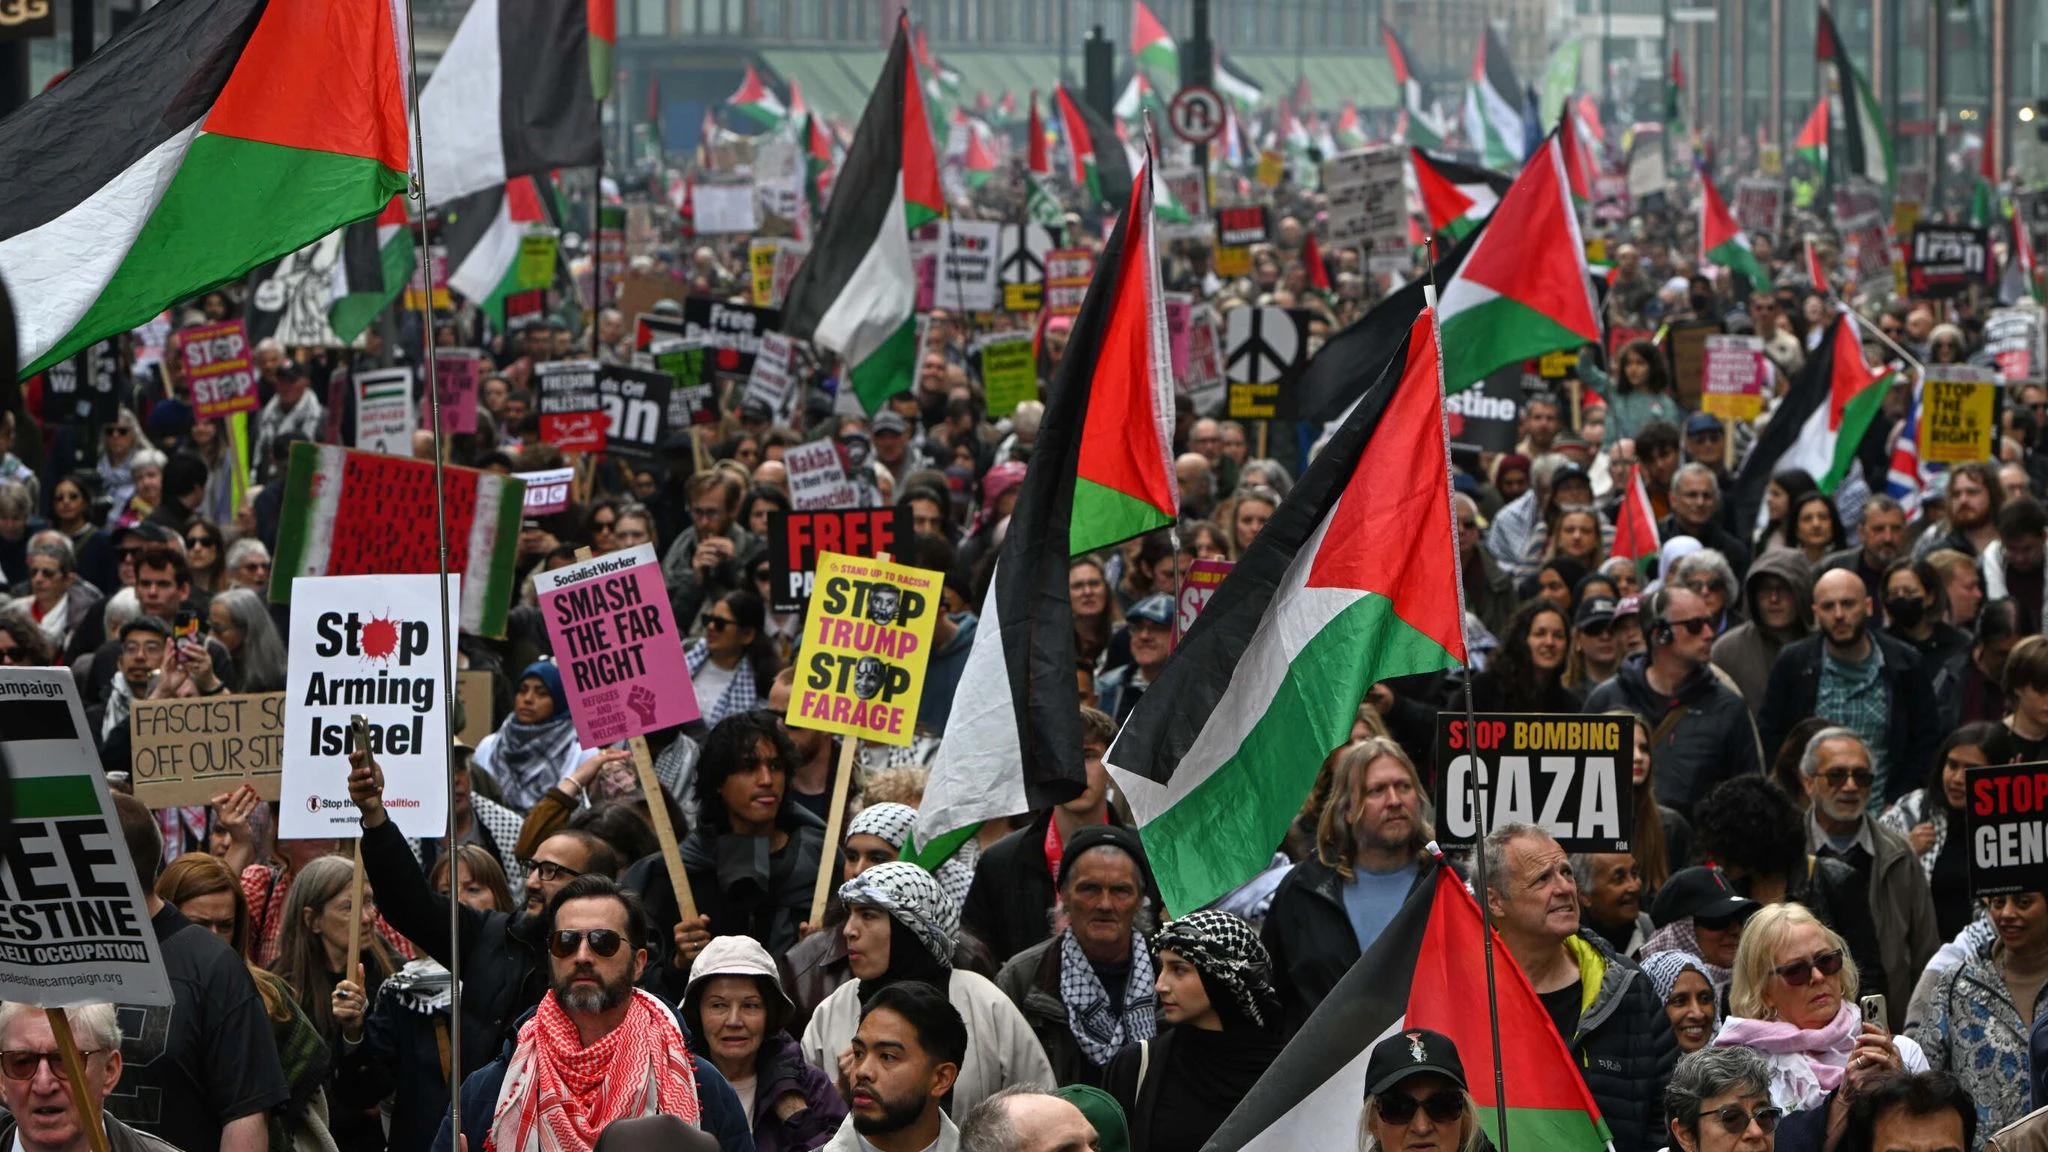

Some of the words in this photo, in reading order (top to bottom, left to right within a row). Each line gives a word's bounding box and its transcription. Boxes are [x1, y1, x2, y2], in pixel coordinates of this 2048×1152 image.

[710, 303, 756, 331] Free
[541, 373, 596, 392] FREEDOM
[1933, 383, 1977, 398] STOP
[1934, 399, 1962, 412] THE
[1932, 415, 1961, 428] FAR
[1931, 430, 1982, 444] RIGHT
[788, 447, 834, 476] Nakba
[787, 510, 896, 571] FREE
[553, 562, 598, 587] Socialist
[598, 556, 637, 575] Worker
[841, 564, 868, 577] STAND
[871, 568, 882, 578] UP
[885, 571, 895, 580] TO
[898, 574, 930, 588] RACISM
[553, 574, 642, 625] SMASH
[823, 577, 926, 627] STOP
[561, 618, 612, 659] THE
[613, 604, 664, 645] FAR
[819, 616, 918, 660] TRUMP
[571, 644, 646, 692] RIGHT
[807, 651, 911, 703] STOP
[304, 670, 434, 713] Arming
[582, 689, 620, 708] REFUGEES
[136, 700, 248, 736] FASCIST
[587, 711, 627, 730] MIGRANTS
[597, 703, 613, 716] AND
[800, 691, 905, 735] FARAGE
[310, 715, 424, 756] Israel
[592, 723, 628, 742] WELCOME
[1449, 720, 1507, 749] STOP
[1514, 721, 1620, 750] BOMBING
[135, 745, 184, 778] OFF
[190, 737, 245, 773] OUR
[322, 799, 342, 810] Stop
[1446, 754, 1620, 839] GAZA
[1974, 773, 2048, 816] STOP
[329, 816, 361, 824] www.stop
[1975, 820, 2048, 869] GEN
[34, 943, 147, 964] OCCUPATION
